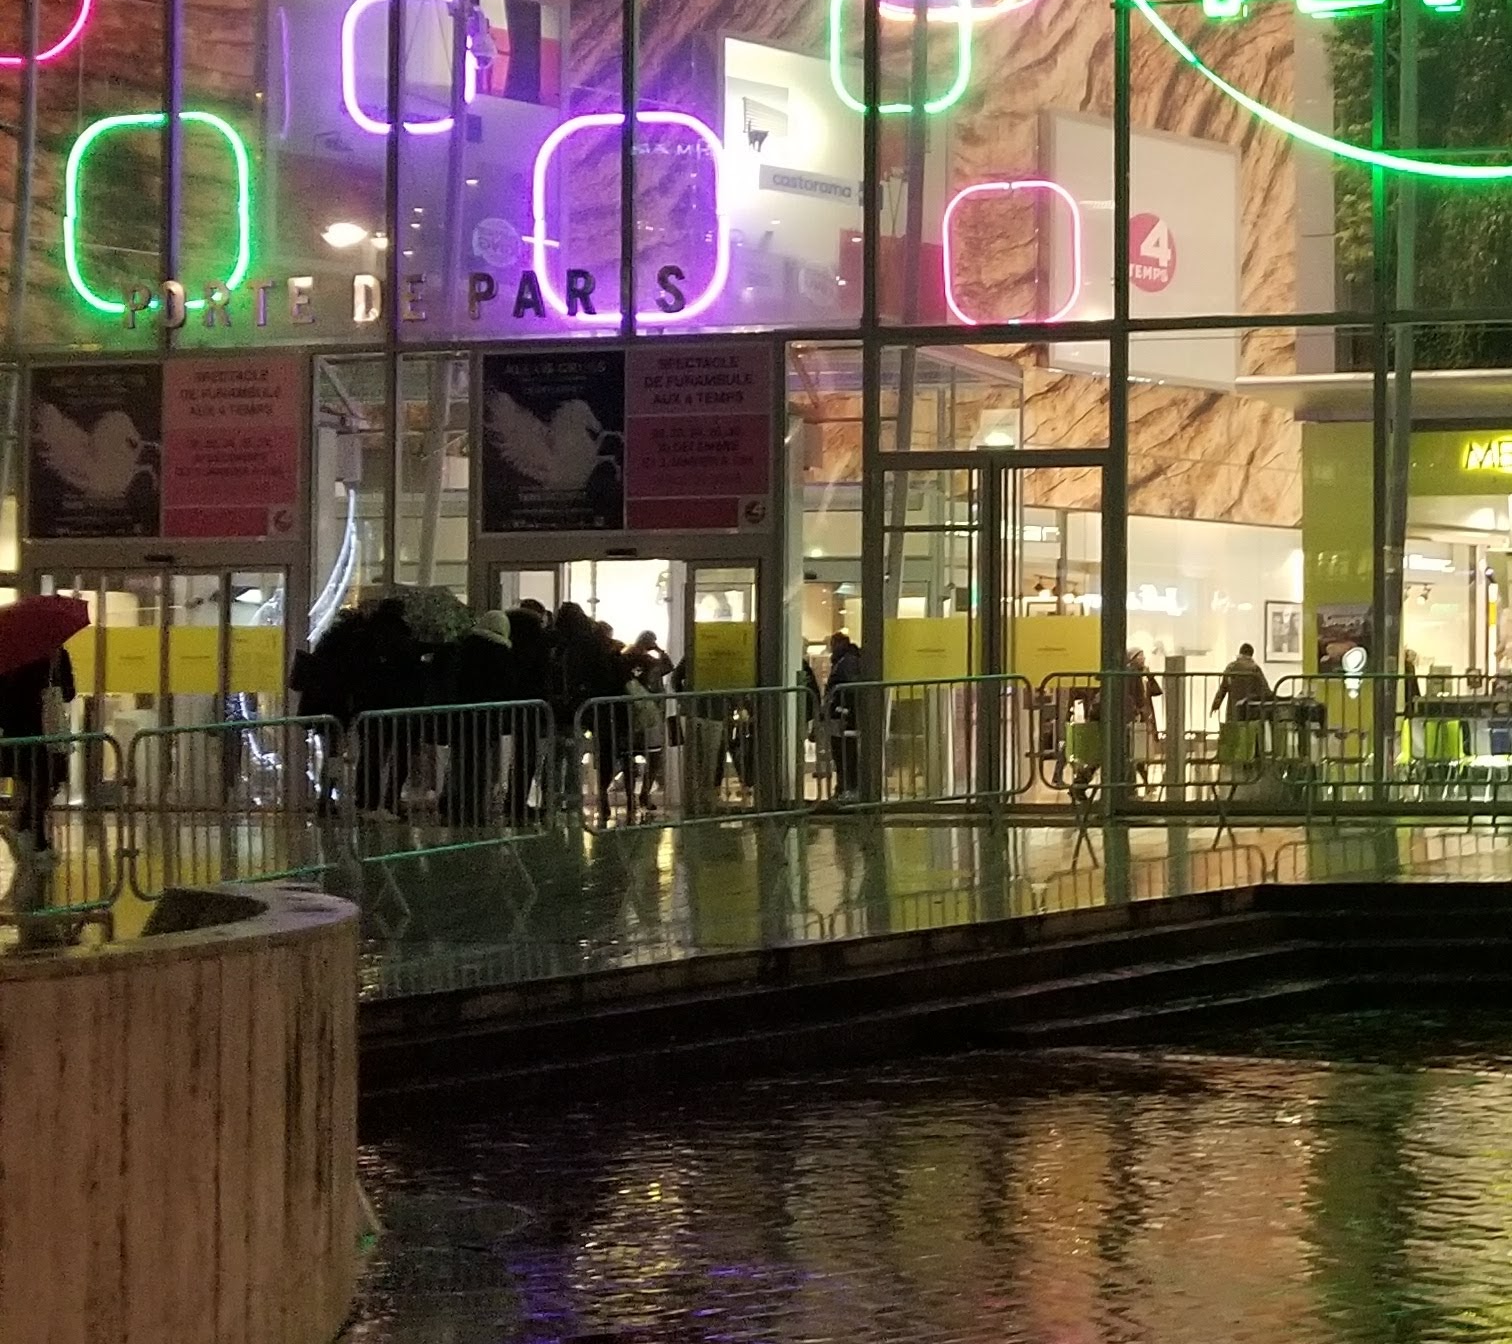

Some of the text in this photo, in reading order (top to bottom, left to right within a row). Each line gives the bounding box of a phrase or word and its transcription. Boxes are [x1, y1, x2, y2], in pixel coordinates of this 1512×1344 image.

[772, 174, 852, 198] castorama
[1139, 218, 1172, 268] 4
[1129, 262, 1169, 283] TEMPS
[123, 263, 686, 330] PORTE DE PARS
